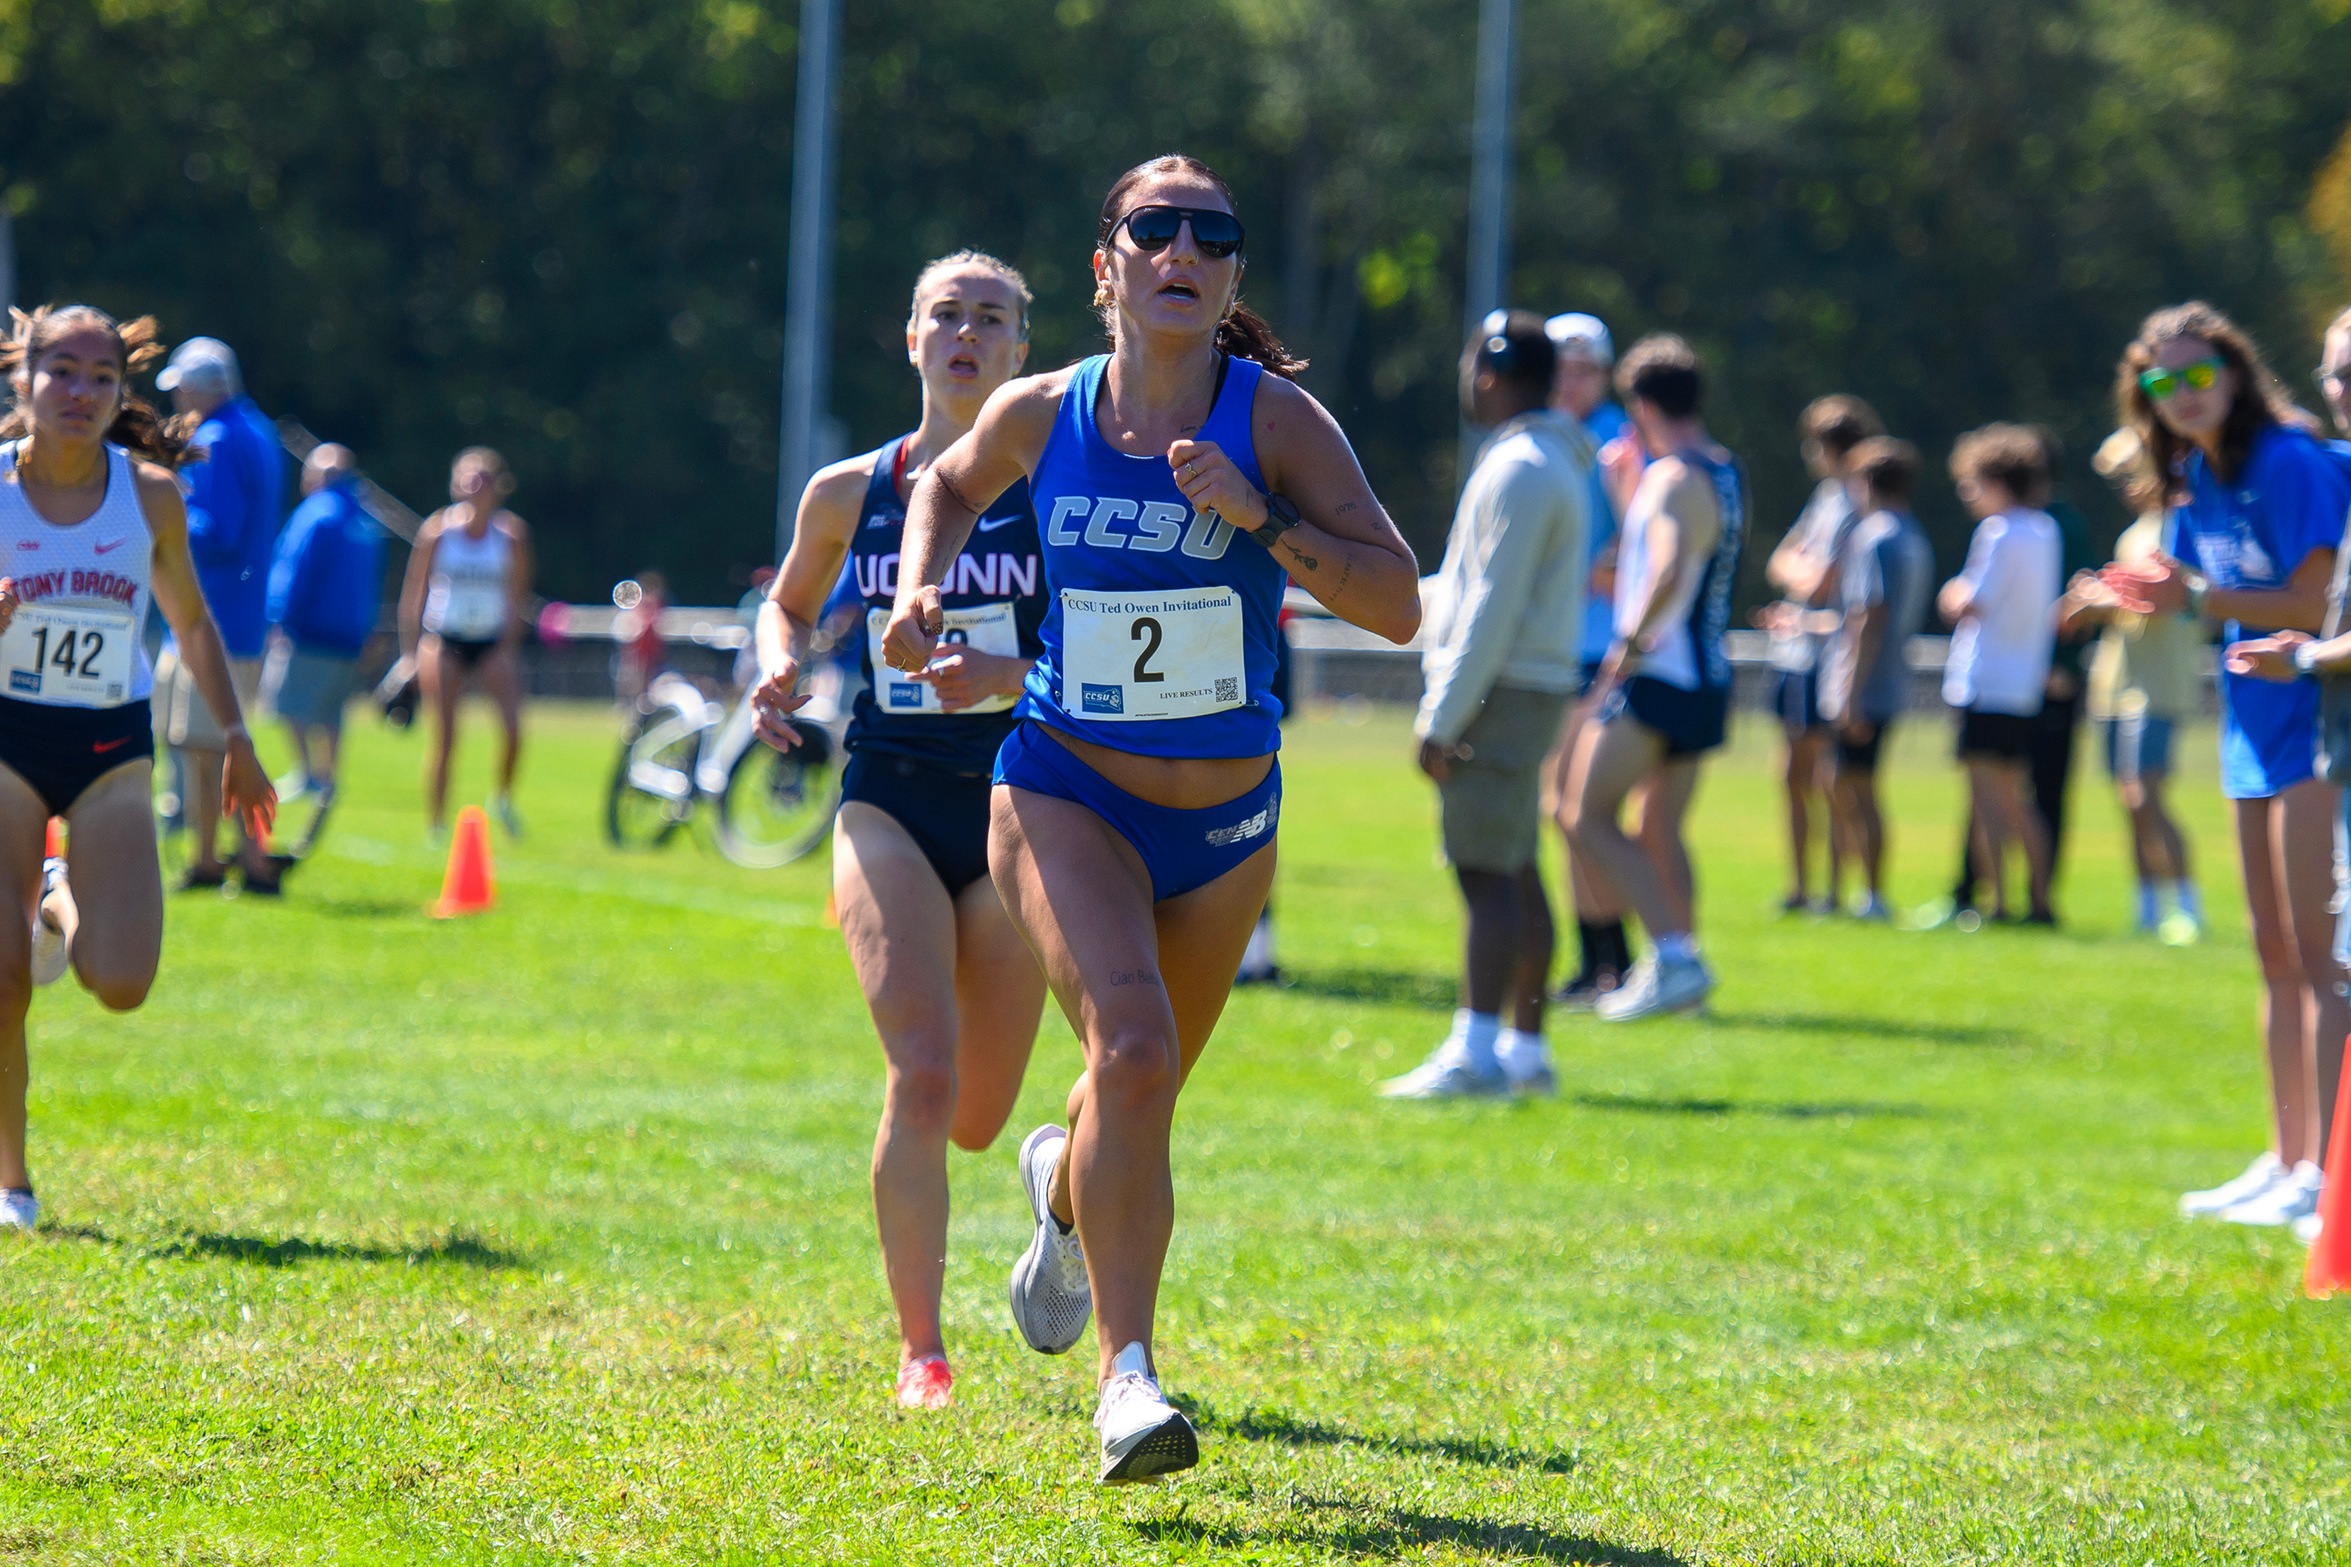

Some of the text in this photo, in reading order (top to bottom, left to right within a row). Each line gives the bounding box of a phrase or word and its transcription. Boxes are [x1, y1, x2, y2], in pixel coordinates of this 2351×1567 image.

[1047, 495, 1237, 560] CCSU
[10, 570, 137, 609] TONY BROOK
[855, 552, 1038, 598] UCNN
[1068, 596, 1232, 613] CCSU Ted Owen Invitational
[31, 626, 105, 679] 142
[1131, 616, 1165, 683] 2
[1084, 691, 1110, 701] CCSU
[1160, 688, 1213, 700] LIVE RESULTS
[1110, 970, 1135, 987] Ciao
